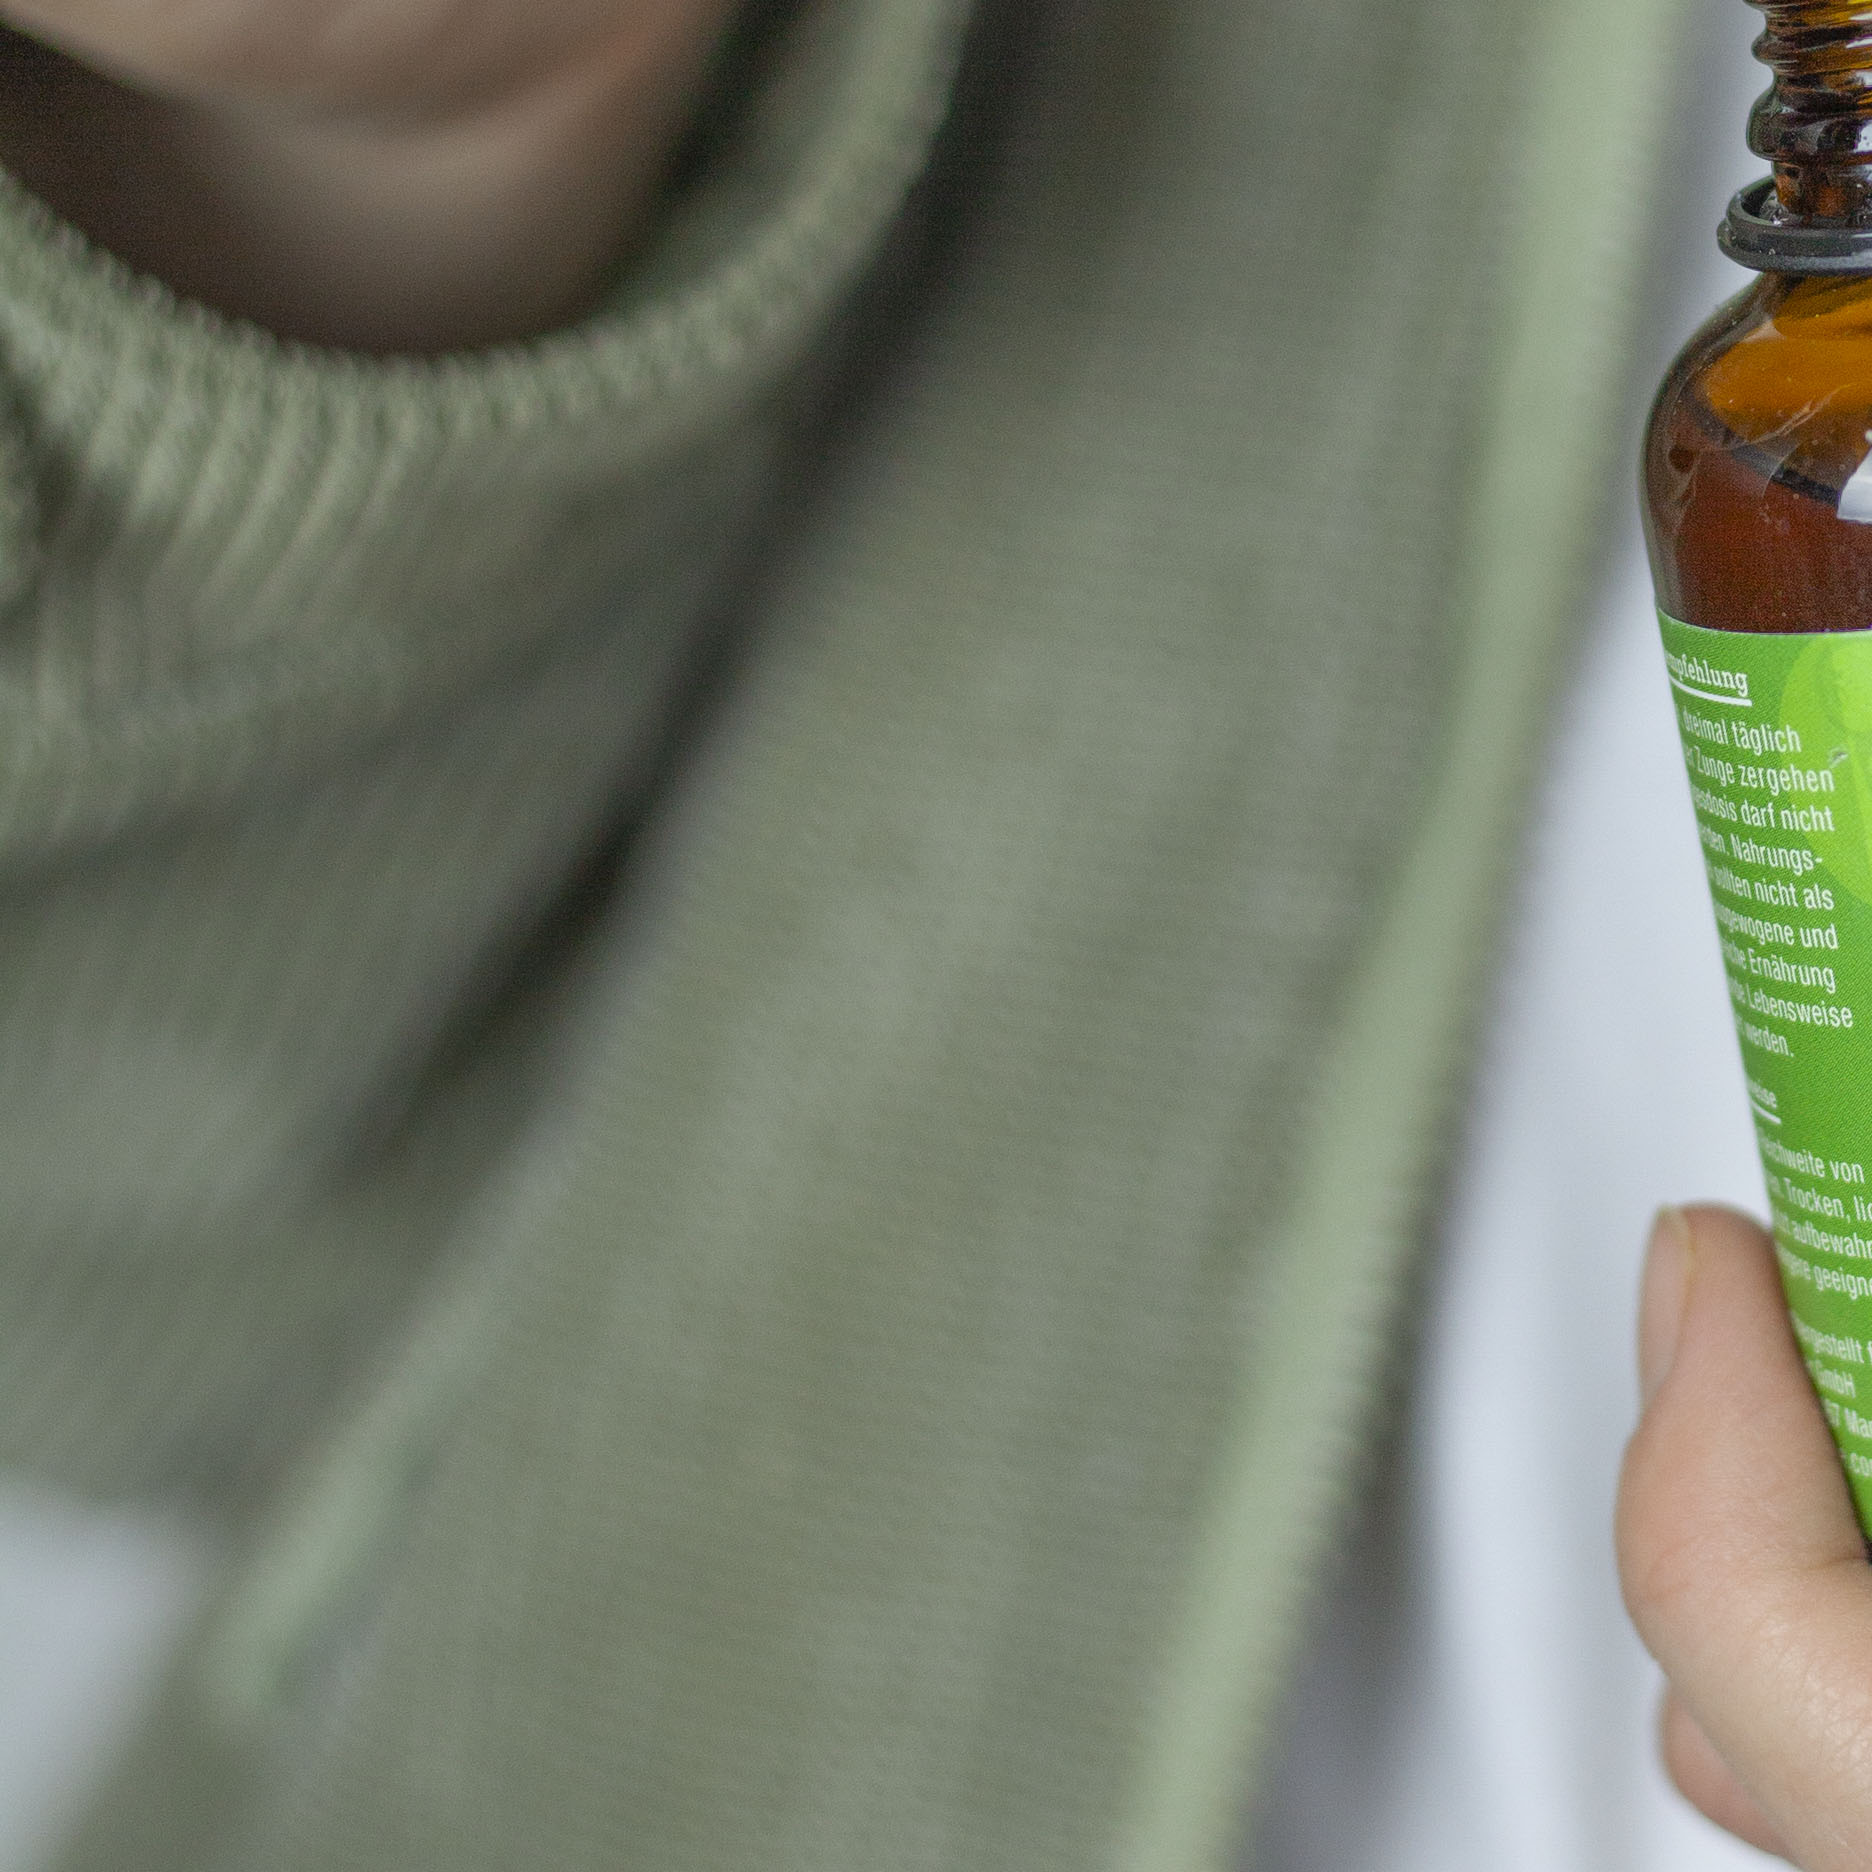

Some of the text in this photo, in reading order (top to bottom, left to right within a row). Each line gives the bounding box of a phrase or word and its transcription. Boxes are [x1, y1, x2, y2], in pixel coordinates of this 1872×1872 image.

[1731, 720, 1802, 756] täglich
[1694, 745, 1735, 787] Zunge
[1739, 763, 1835, 796] zergehen
[1741, 799, 1775, 828] darf
[1781, 804, 1836, 832] nicht
[1730, 833, 1823, 876] Nahrungs-
[1754, 879, 1799, 908] nicht
[1803, 884, 1835, 911] als
[1800, 924, 1839, 950] und
[1748, 947, 1836, 994] Ernährung
[1747, 985, 1853, 1028] Lebensweise
[1829, 1160, 1865, 1184] von
[1784, 1177, 1851, 1223] Trocken,
